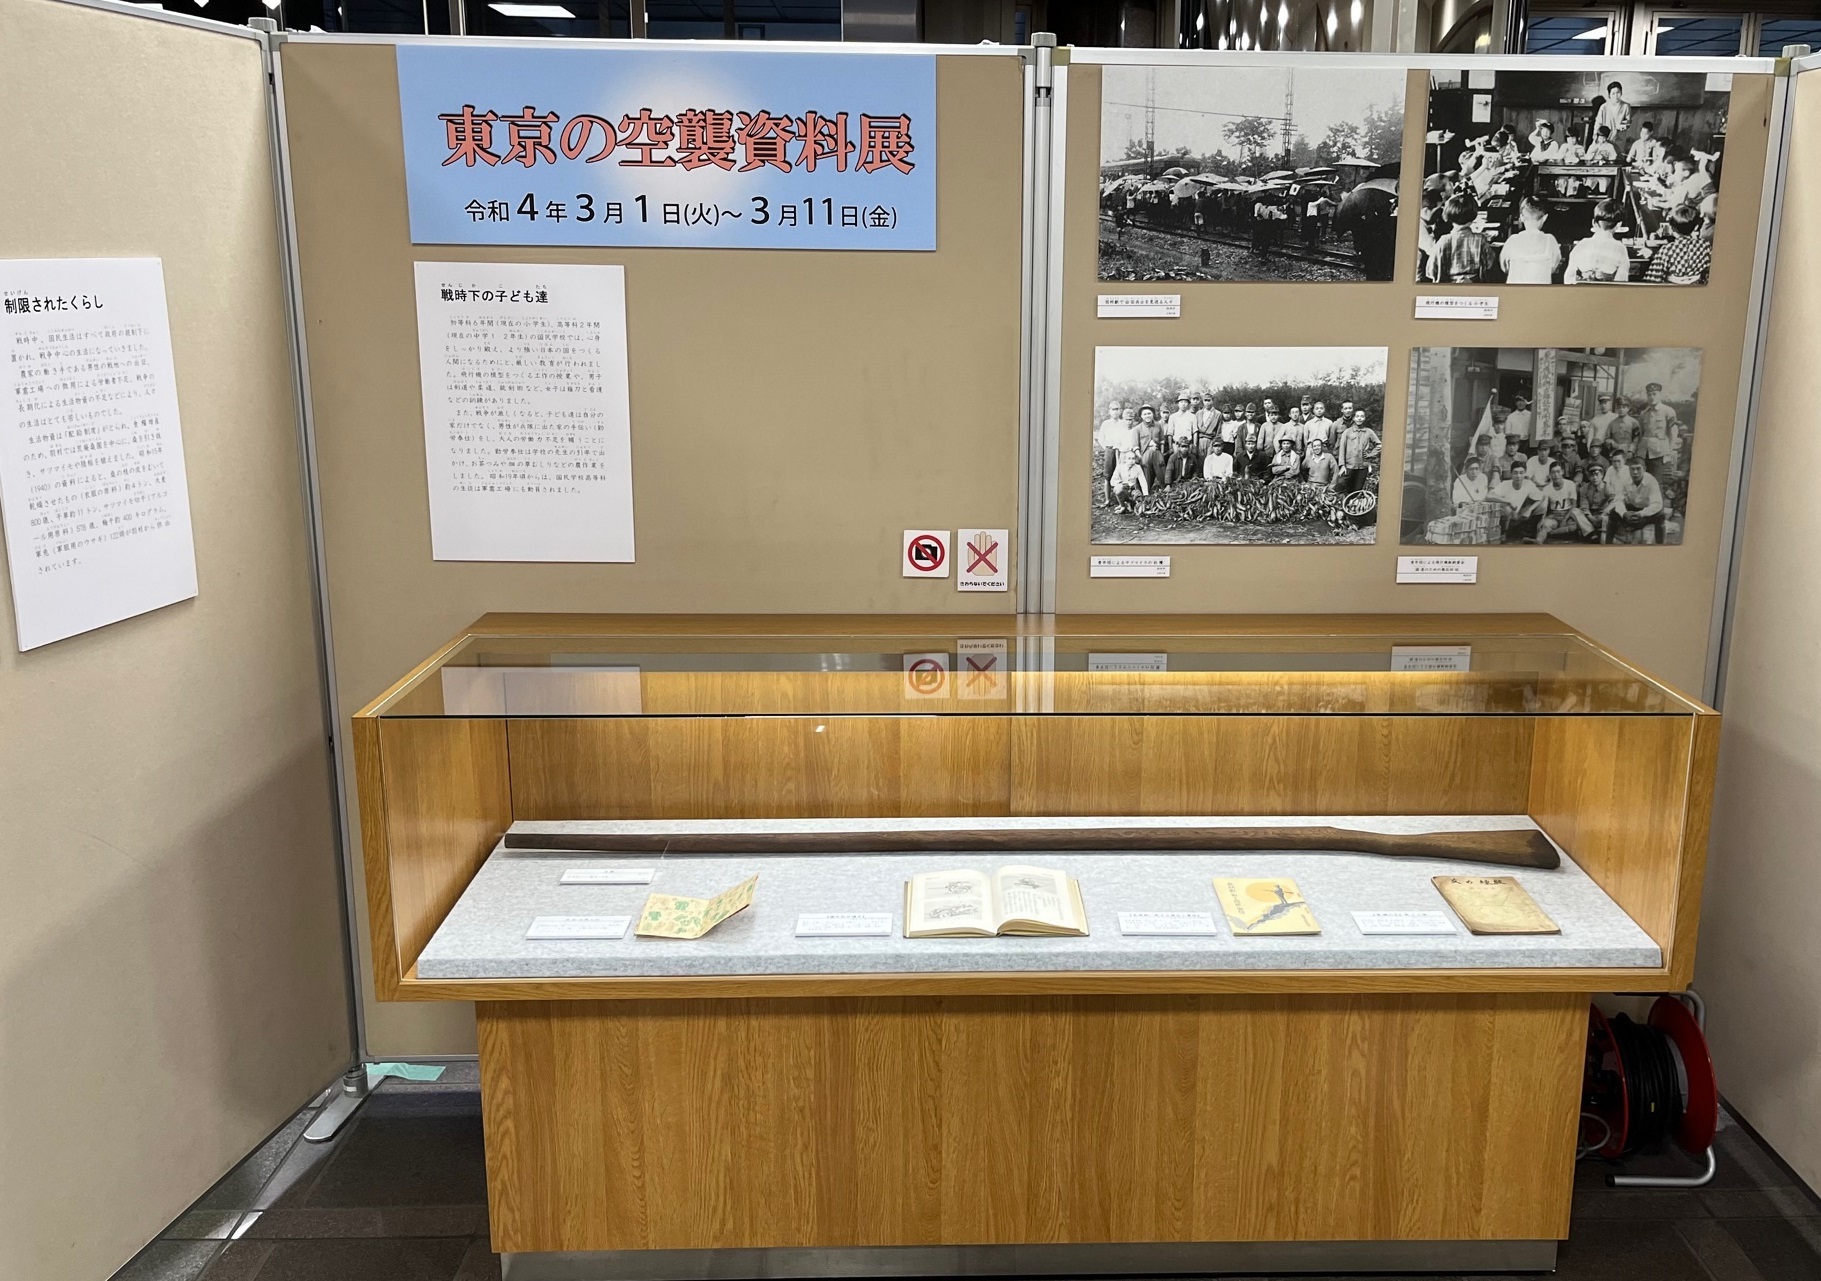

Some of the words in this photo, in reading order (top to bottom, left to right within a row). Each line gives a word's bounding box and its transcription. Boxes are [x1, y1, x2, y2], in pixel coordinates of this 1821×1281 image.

[438, 104, 915, 175] 東京の空襲資料展
[4, 295, 104, 314] 制限されたくらし
[441, 289, 549, 303] 戦時下の子ども達
